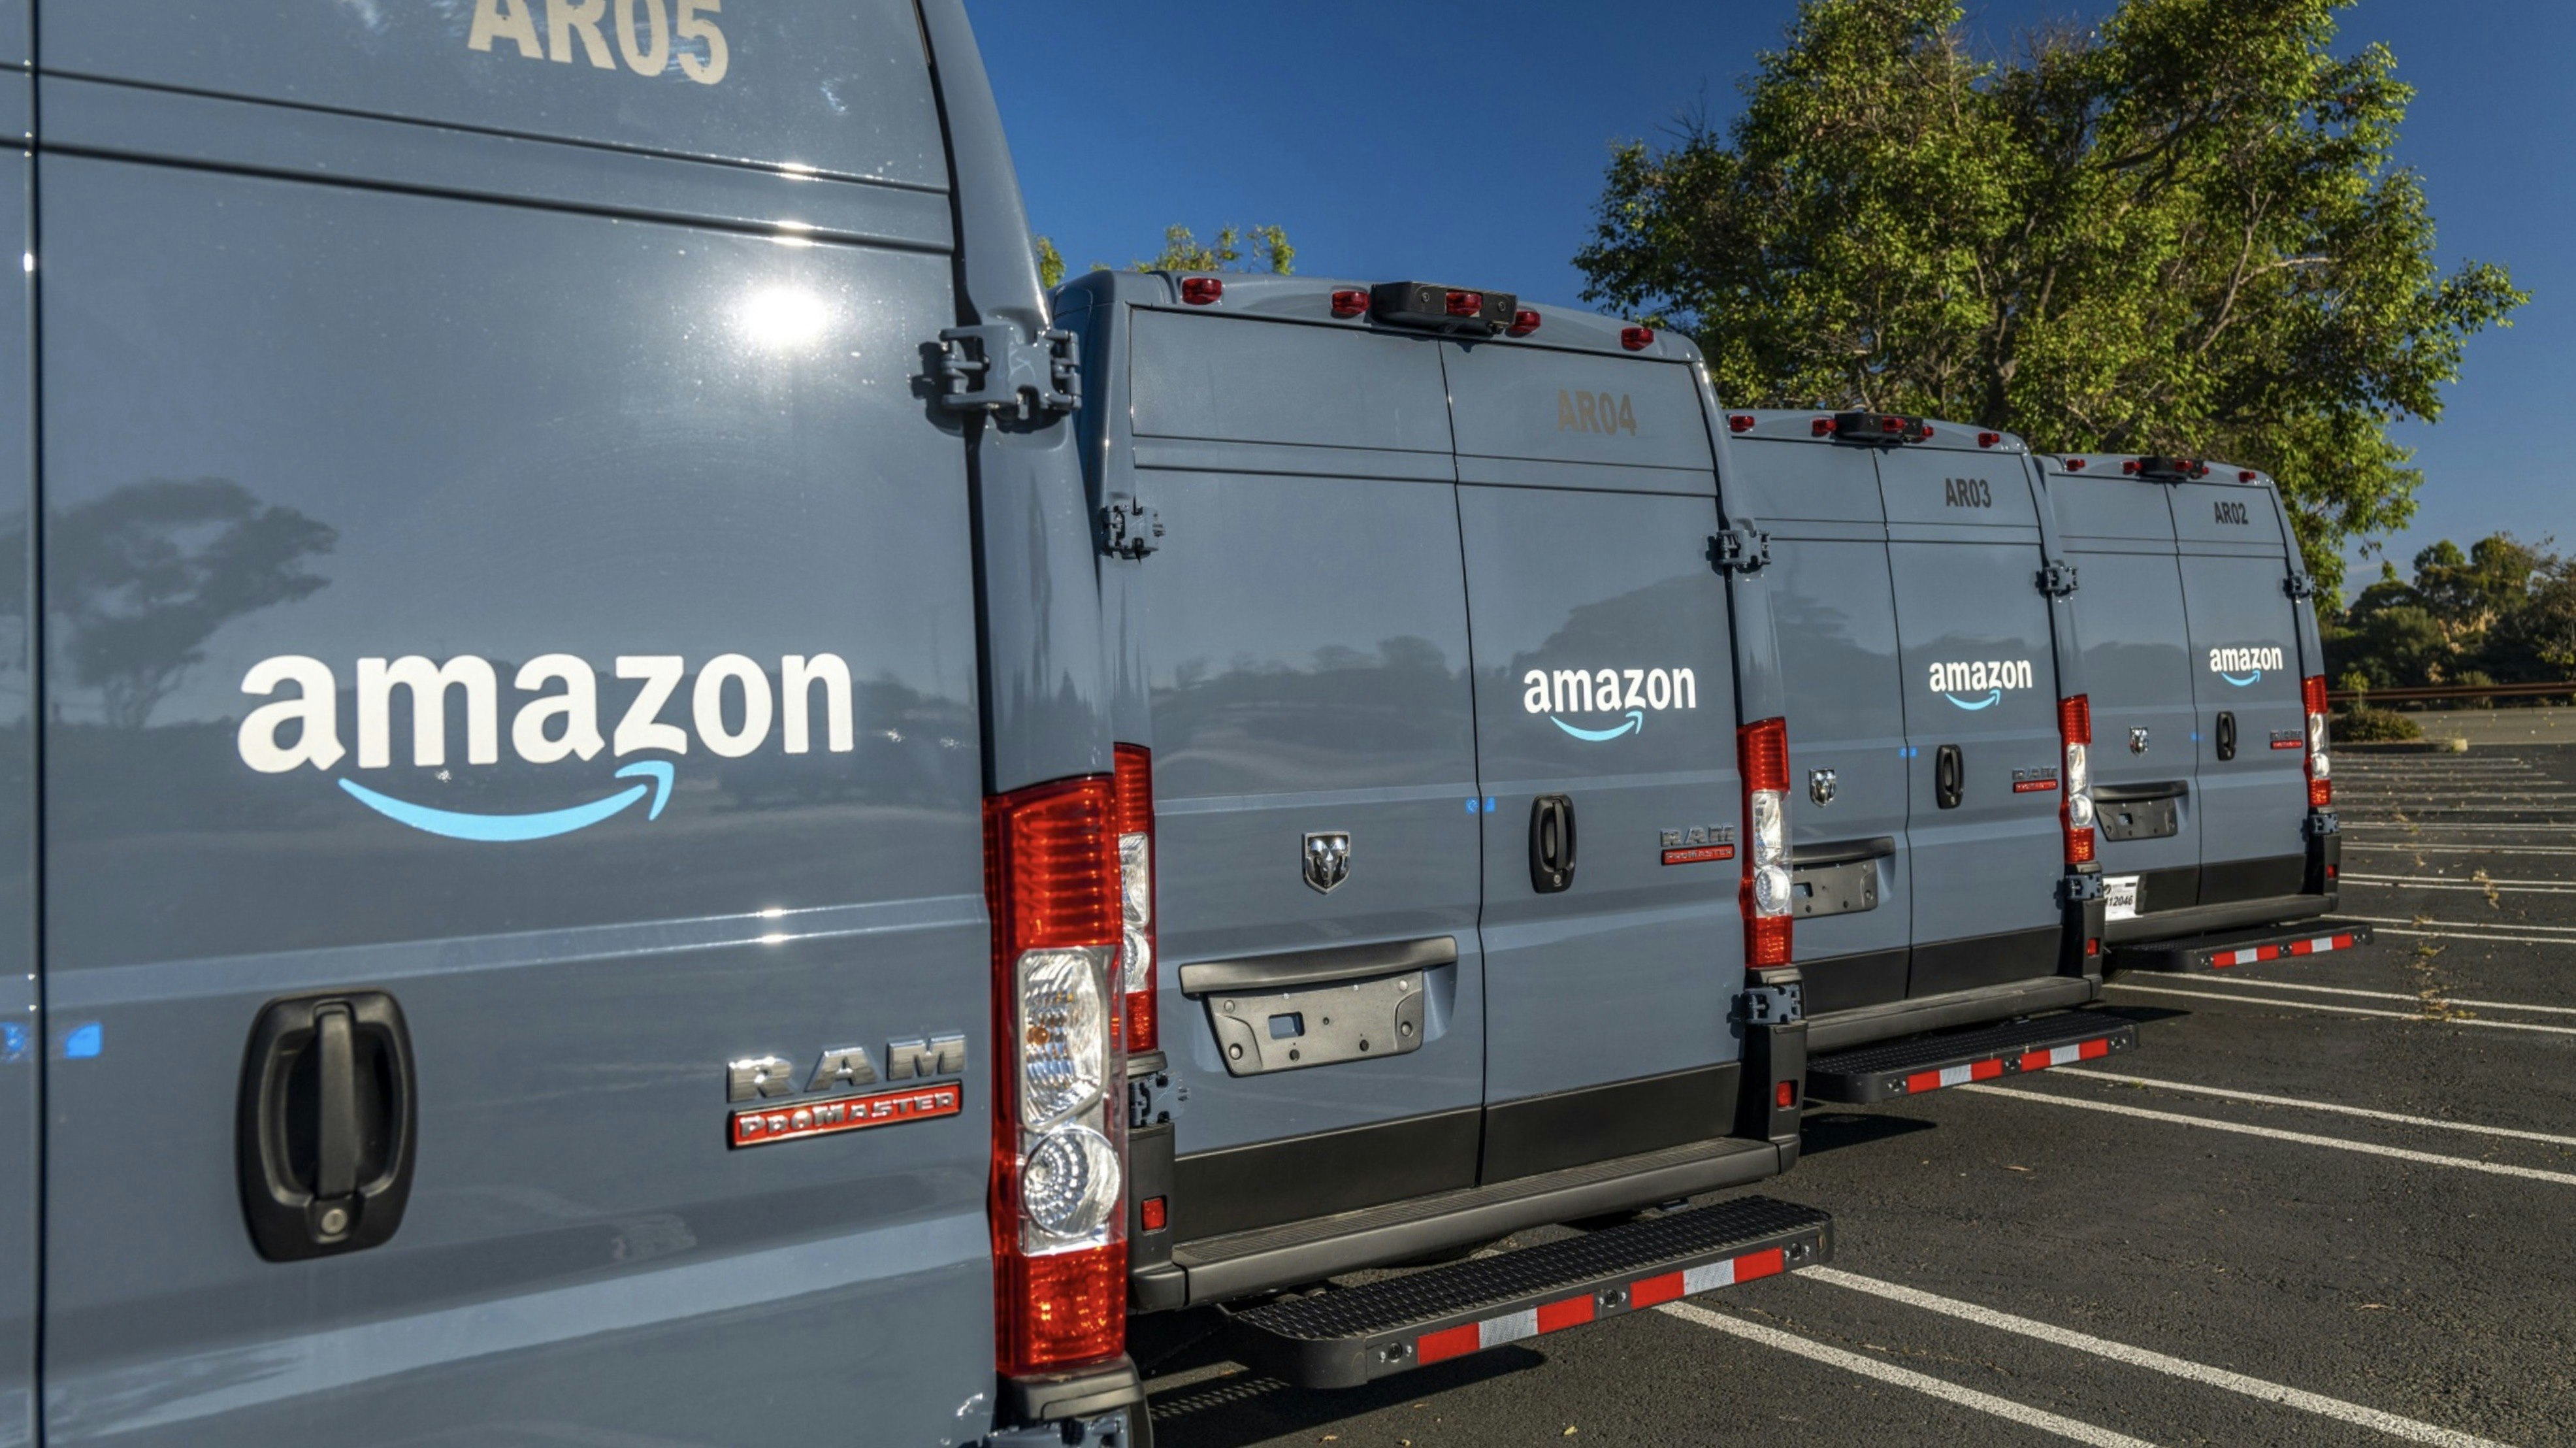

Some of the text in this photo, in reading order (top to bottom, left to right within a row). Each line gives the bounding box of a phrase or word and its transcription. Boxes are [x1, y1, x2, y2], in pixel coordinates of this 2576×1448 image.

[468, 0, 728, 84] AR05
[1557, 390, 1637, 436] AR04
[1946, 478, 1991, 508] AR03
[2214, 502, 2249, 525] AR02
[1929, 660, 2032, 691] amazon
[2209, 647, 2283, 672] amazon
[238, 653, 854, 773] amazon
[1524, 668, 1696, 713] amazon
[1660, 823, 1735, 847] RAM
[727, 1034, 966, 1103] RAM
[739, 1092, 955, 1138] PROMASTER
